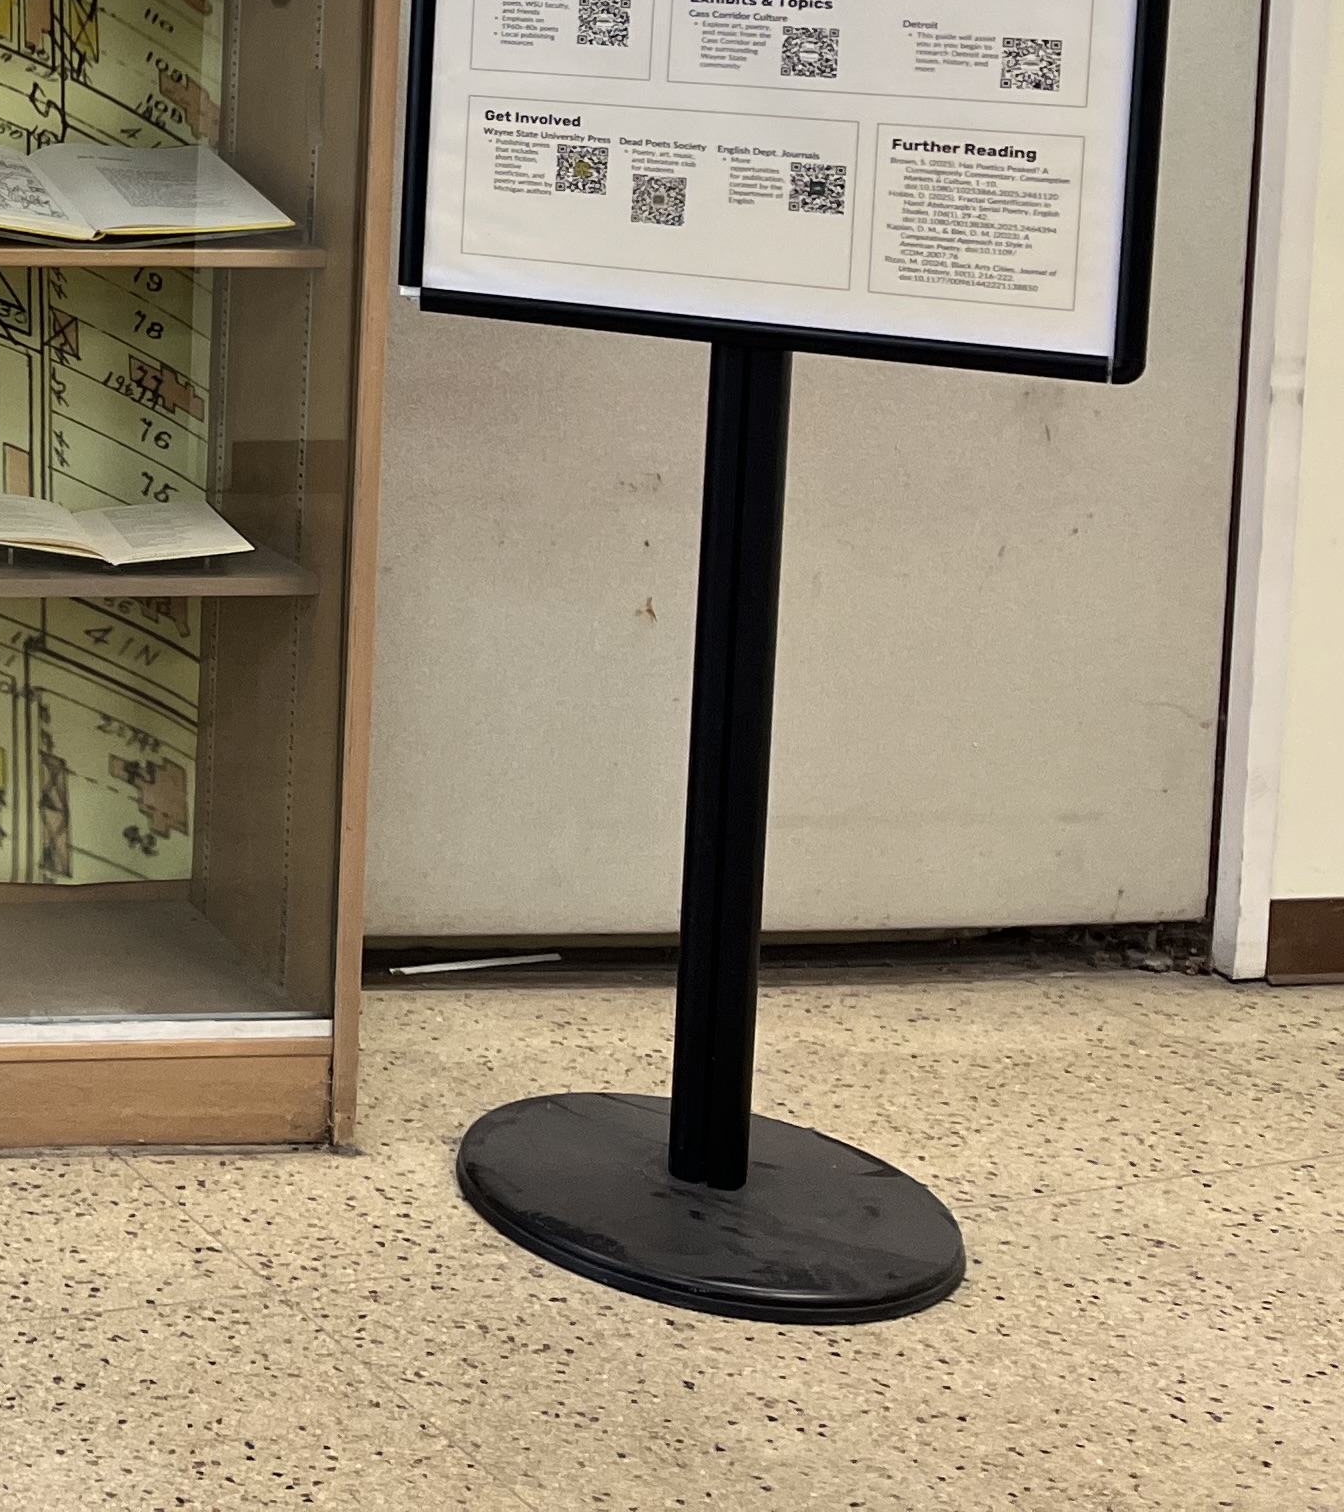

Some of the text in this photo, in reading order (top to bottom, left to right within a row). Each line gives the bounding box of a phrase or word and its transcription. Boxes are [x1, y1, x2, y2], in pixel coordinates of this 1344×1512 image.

[689, 9, 788, 23] Cass Corridor Culture
[902, 19, 938, 30] Detroit
[486, 110, 581, 127] Get Involved
[484, 127, 613, 144] Wayne State University Press
[620, 137, 707, 152] Dead Poets Society
[893, 139, 1037, 161] Further Reading
